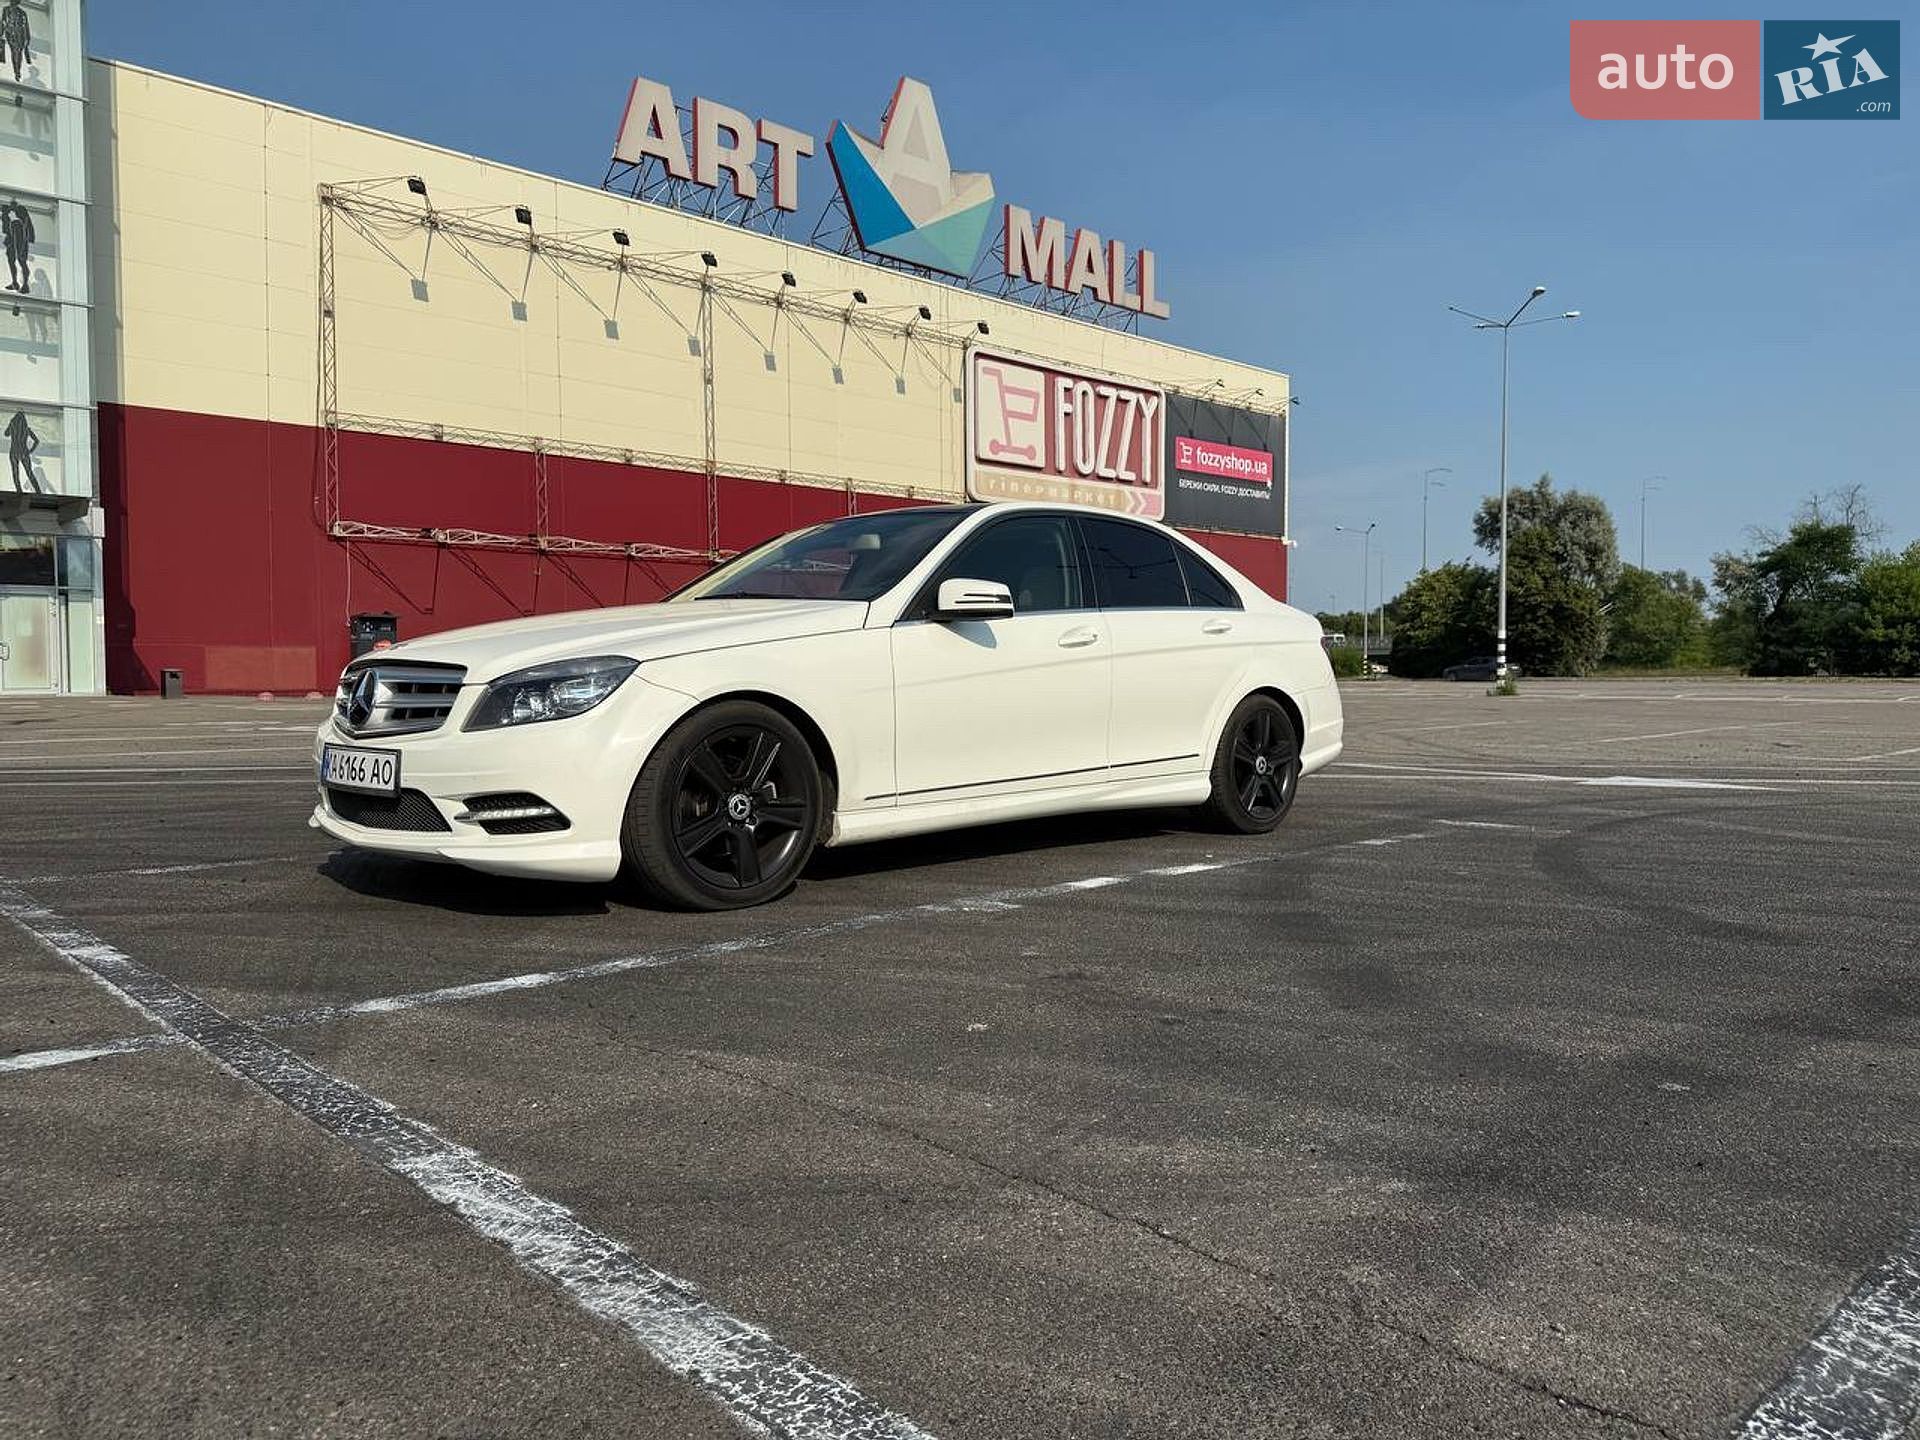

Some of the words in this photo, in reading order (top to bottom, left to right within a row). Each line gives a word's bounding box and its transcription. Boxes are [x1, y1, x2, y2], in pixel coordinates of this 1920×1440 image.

[612, 76, 814, 212] ART
[1003, 203, 1170, 320] MALL
[1055, 376, 1158, 483] FOZZY
[1196, 446, 1268, 475] fozzyshop.ua
